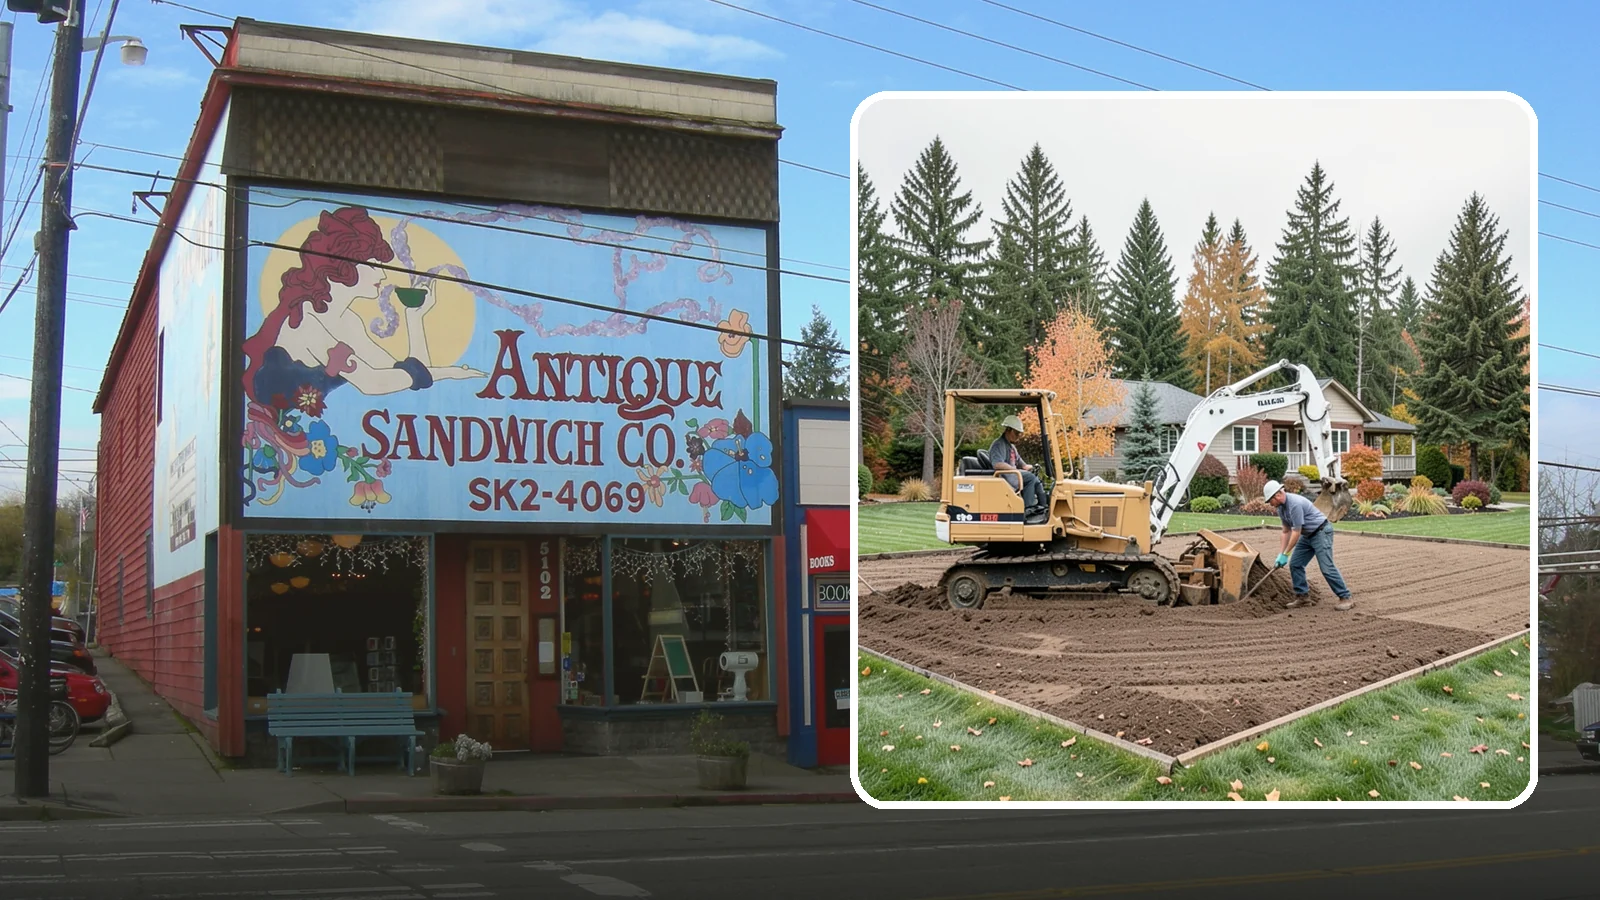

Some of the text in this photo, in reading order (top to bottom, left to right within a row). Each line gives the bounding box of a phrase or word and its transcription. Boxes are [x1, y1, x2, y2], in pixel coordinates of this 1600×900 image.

[476, 329, 724, 421] ANTIQUE
[361, 408, 684, 469] SANDWICH CO.
[468, 477, 645, 513] SK2-4069
[540, 542, 551, 599] 5102
[809, 555, 835, 569] BOOKS
